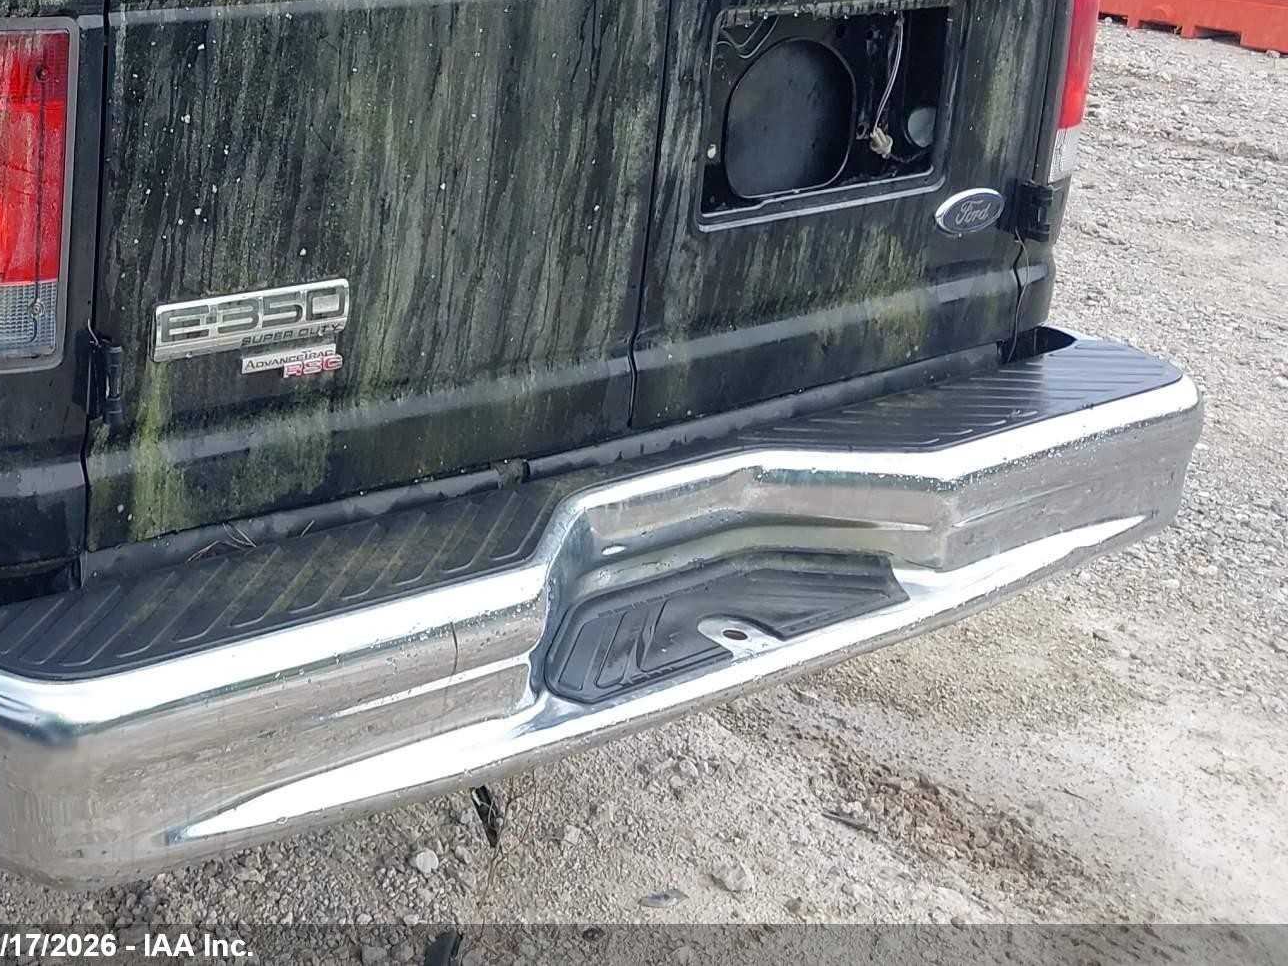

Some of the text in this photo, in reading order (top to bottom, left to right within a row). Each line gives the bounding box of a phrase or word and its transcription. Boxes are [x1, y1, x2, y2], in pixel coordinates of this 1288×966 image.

[955, 200, 991, 225] Ford
[241, 322, 341, 346] SUPER DUTY
[283, 354, 343, 378] RSC
